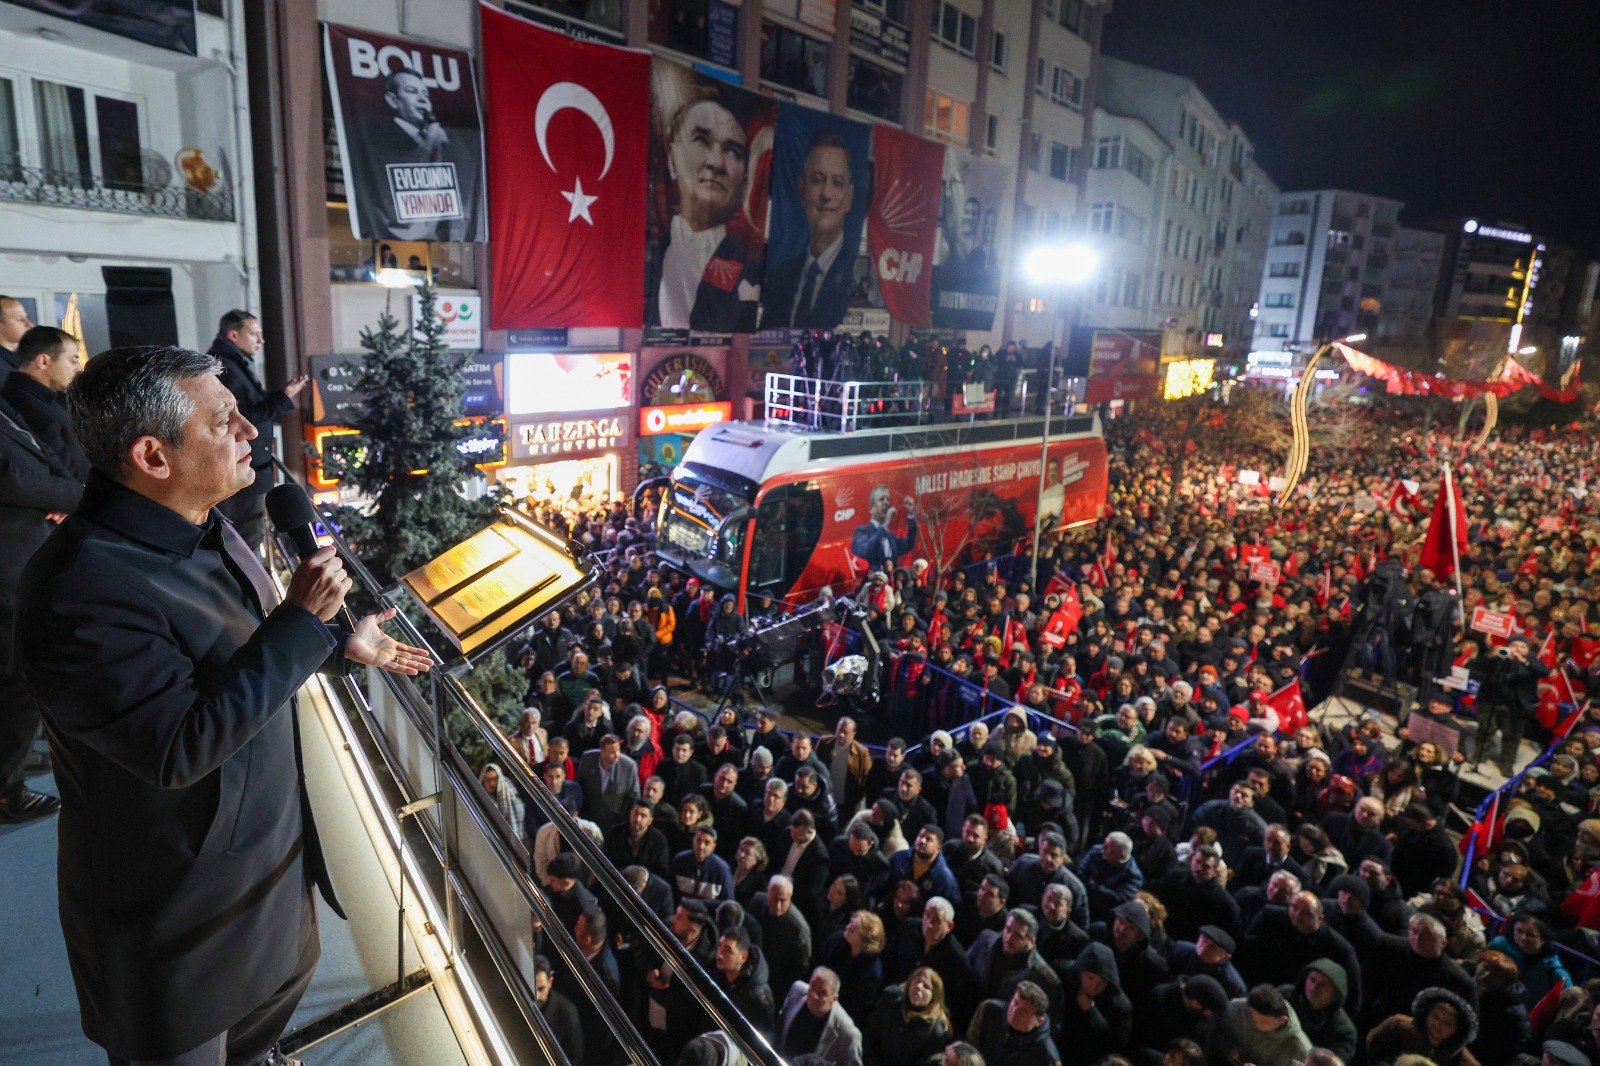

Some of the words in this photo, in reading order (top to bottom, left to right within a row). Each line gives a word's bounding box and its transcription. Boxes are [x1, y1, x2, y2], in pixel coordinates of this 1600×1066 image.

[347, 37, 461, 92] BOLU
[393, 167, 454, 190] EVLADININ
[401, 192, 454, 215] YANINDA
[1017, 458, 1042, 481] ÇIKIYO
[833, 507, 856, 523] CHP
